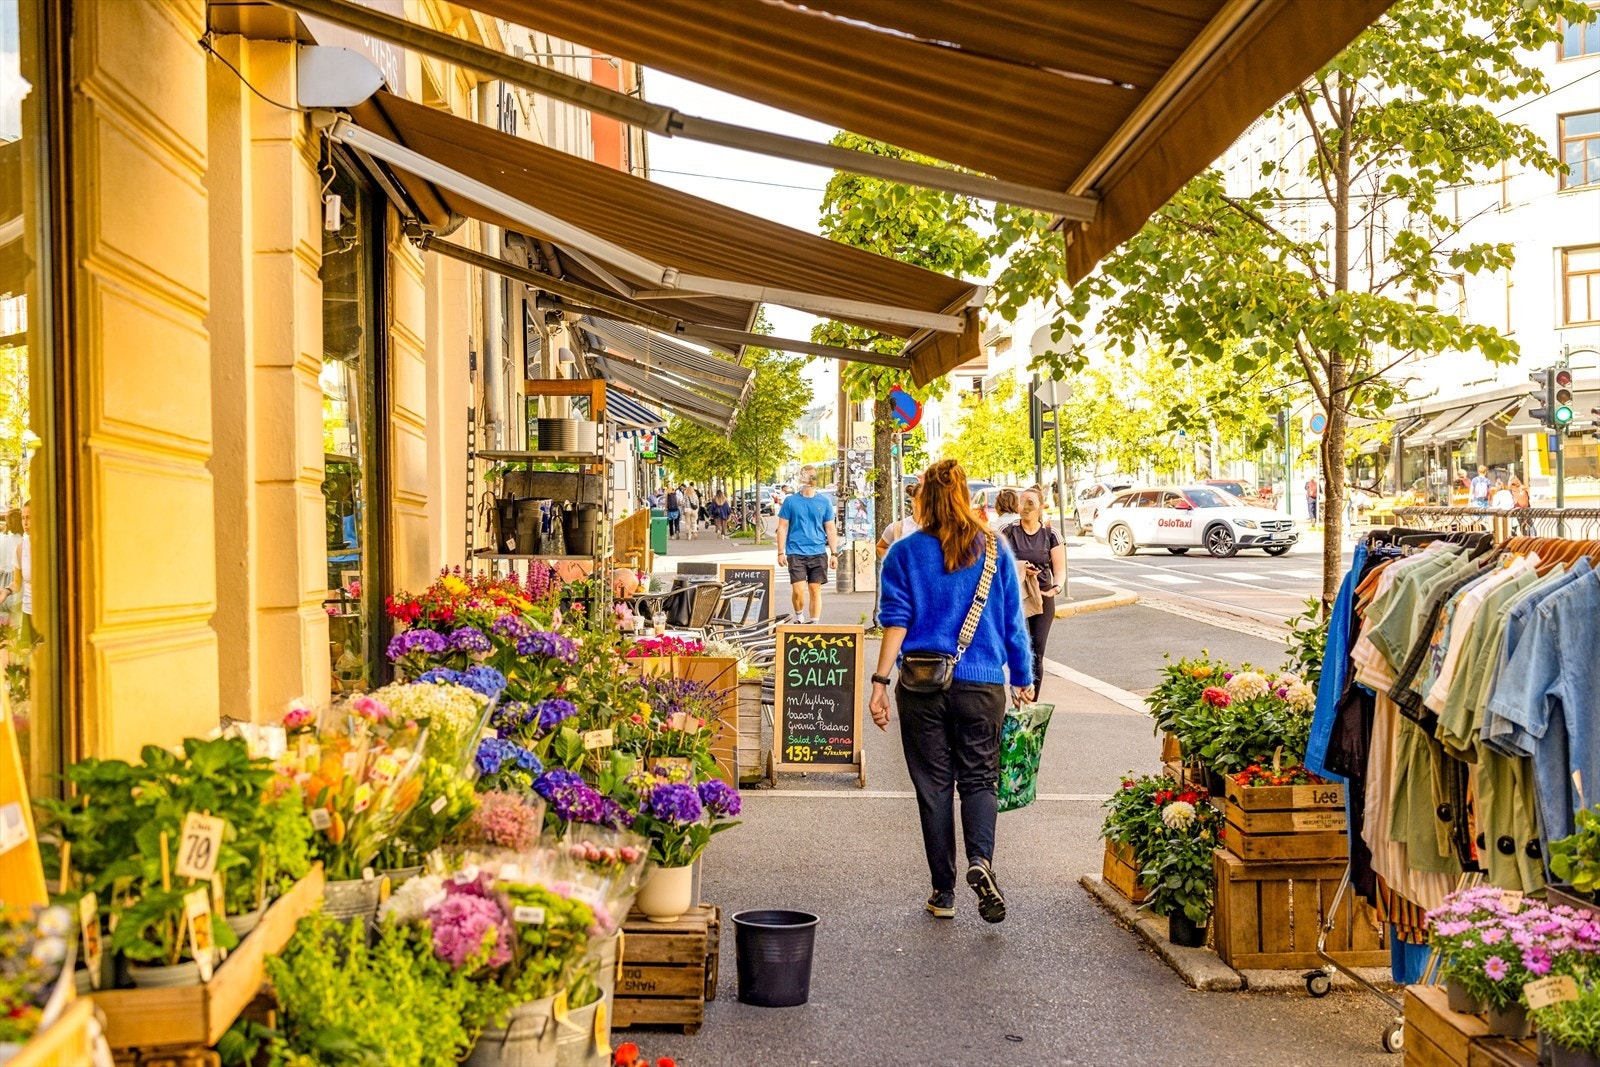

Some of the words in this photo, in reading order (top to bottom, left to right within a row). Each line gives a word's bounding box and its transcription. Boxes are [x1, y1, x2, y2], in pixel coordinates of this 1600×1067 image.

[1158, 518, 1192, 528] OsloTaxi
[734, 571, 761, 579] NYHET
[787, 667, 848, 687] SALAT
[787, 707, 815, 720] bacon
[788, 734, 812, 745] Salat
[813, 734, 828, 746] fra
[1313, 790, 1338, 804] Lee
[186, 834, 211, 871] 79
[625, 981, 656, 992] HANS
